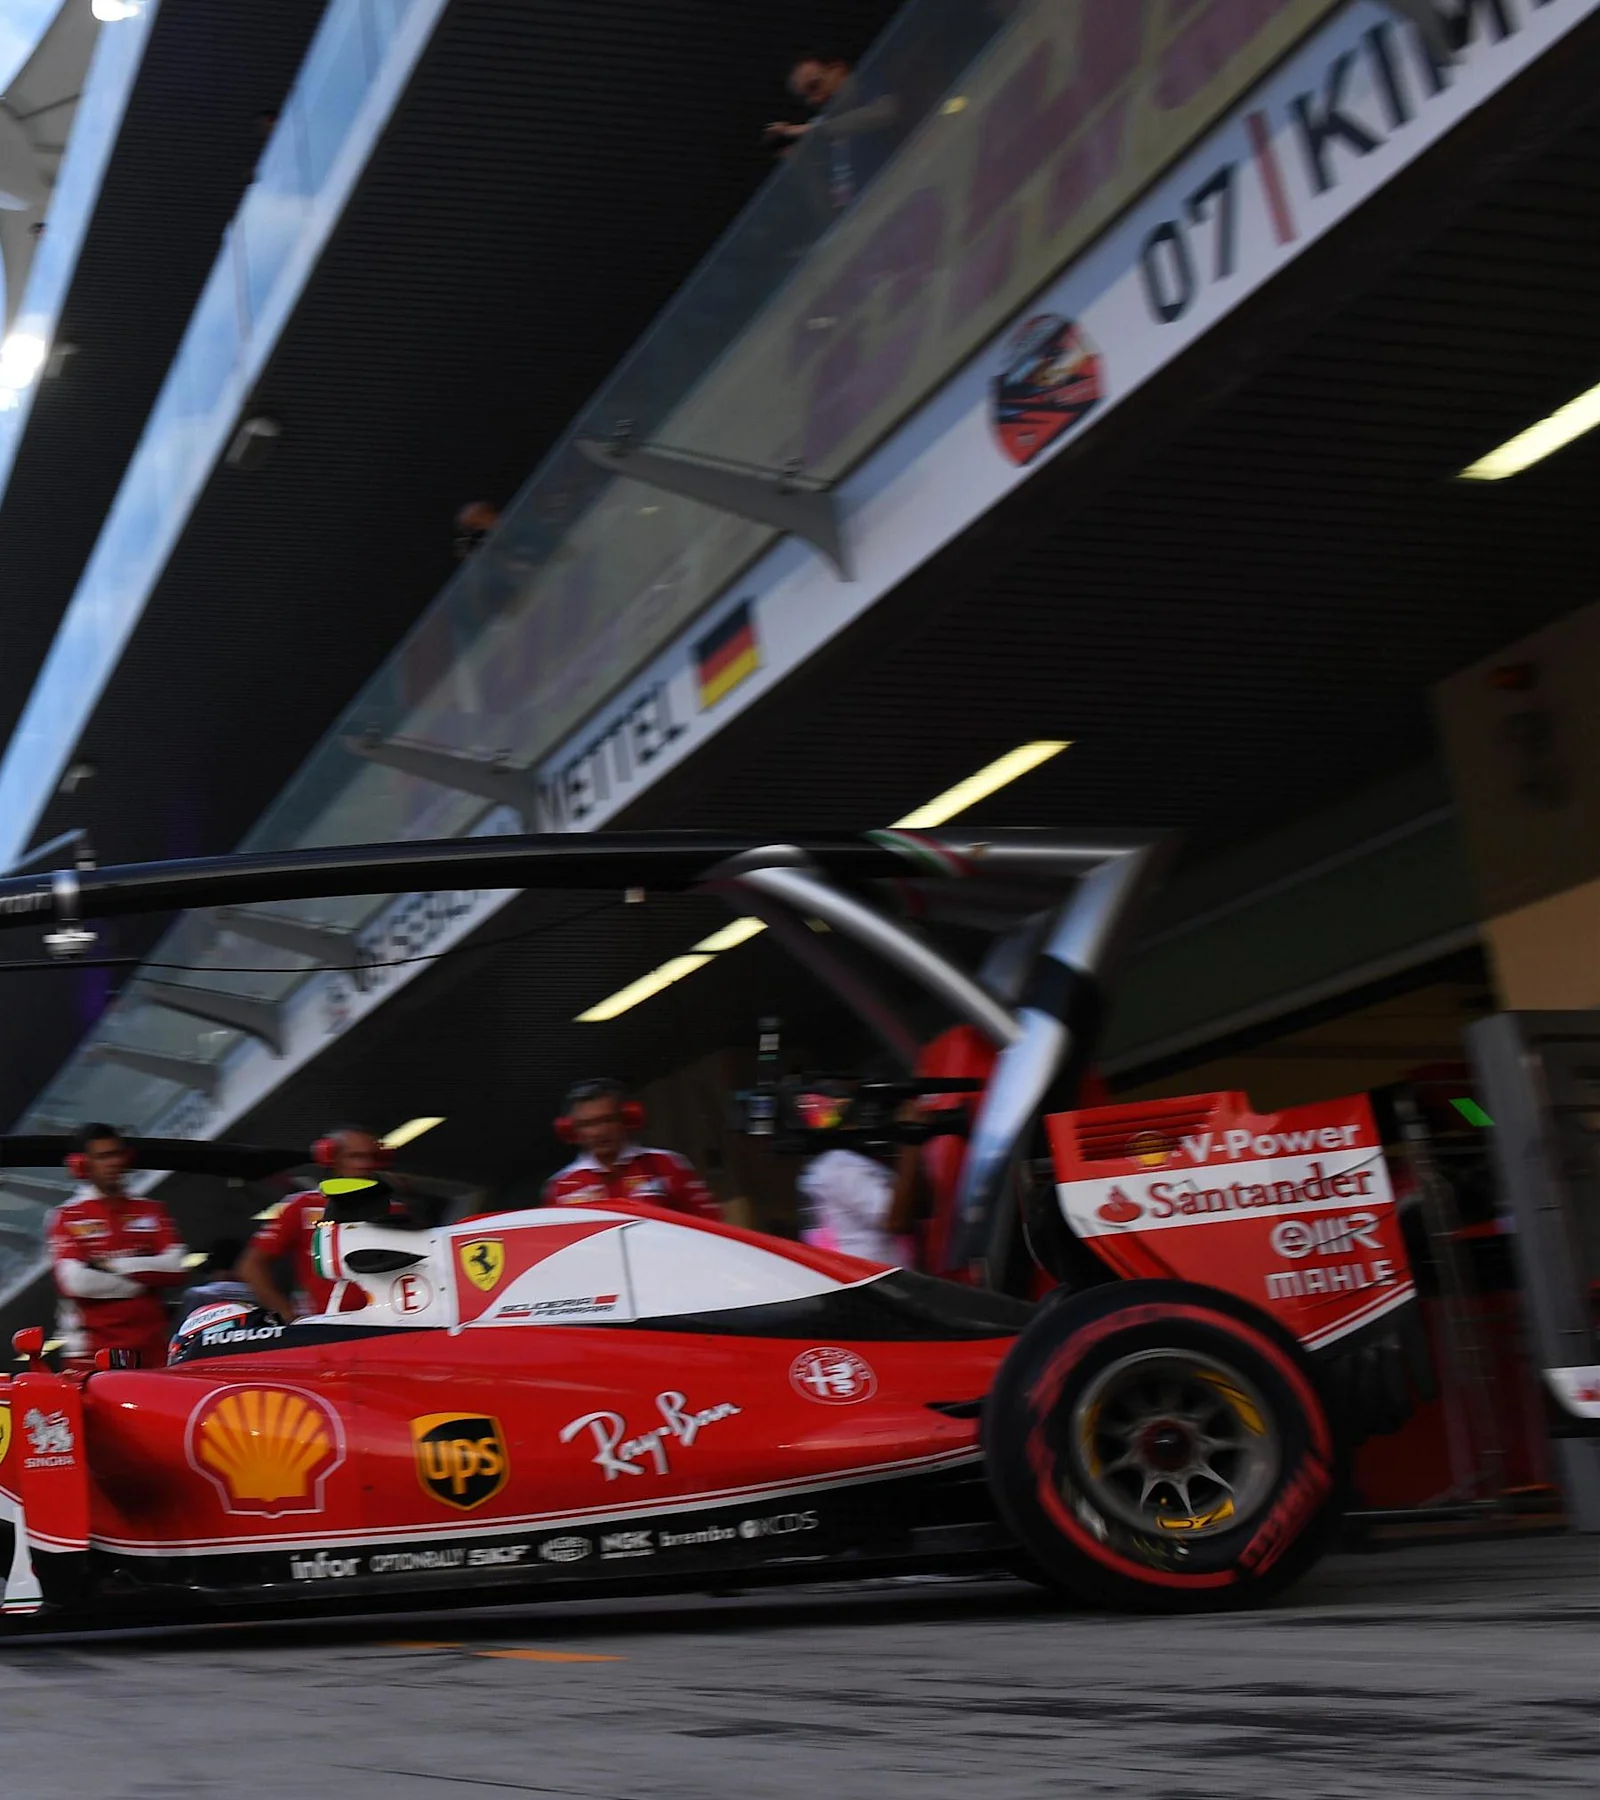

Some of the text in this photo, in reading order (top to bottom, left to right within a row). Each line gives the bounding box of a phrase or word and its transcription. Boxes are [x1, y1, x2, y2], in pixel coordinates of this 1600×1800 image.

[1140, 0, 1551, 324] 07 KIM
[1180, 1124, 1361, 1163] V-Power
[1146, 1162, 1375, 1218] Santander
[402, 1277, 418, 1311] E
[1264, 1260, 1398, 1299] MAHLE
[501, 1297, 593, 1312] SCUDERIA
[532, 1304, 617, 1317] FERRARI
[201, 1326, 287, 1346] HUBLOT
[558, 1391, 743, 1482] Ray-Ban
[659, 1525, 737, 1547] brembo
[290, 1551, 362, 1579] infor
